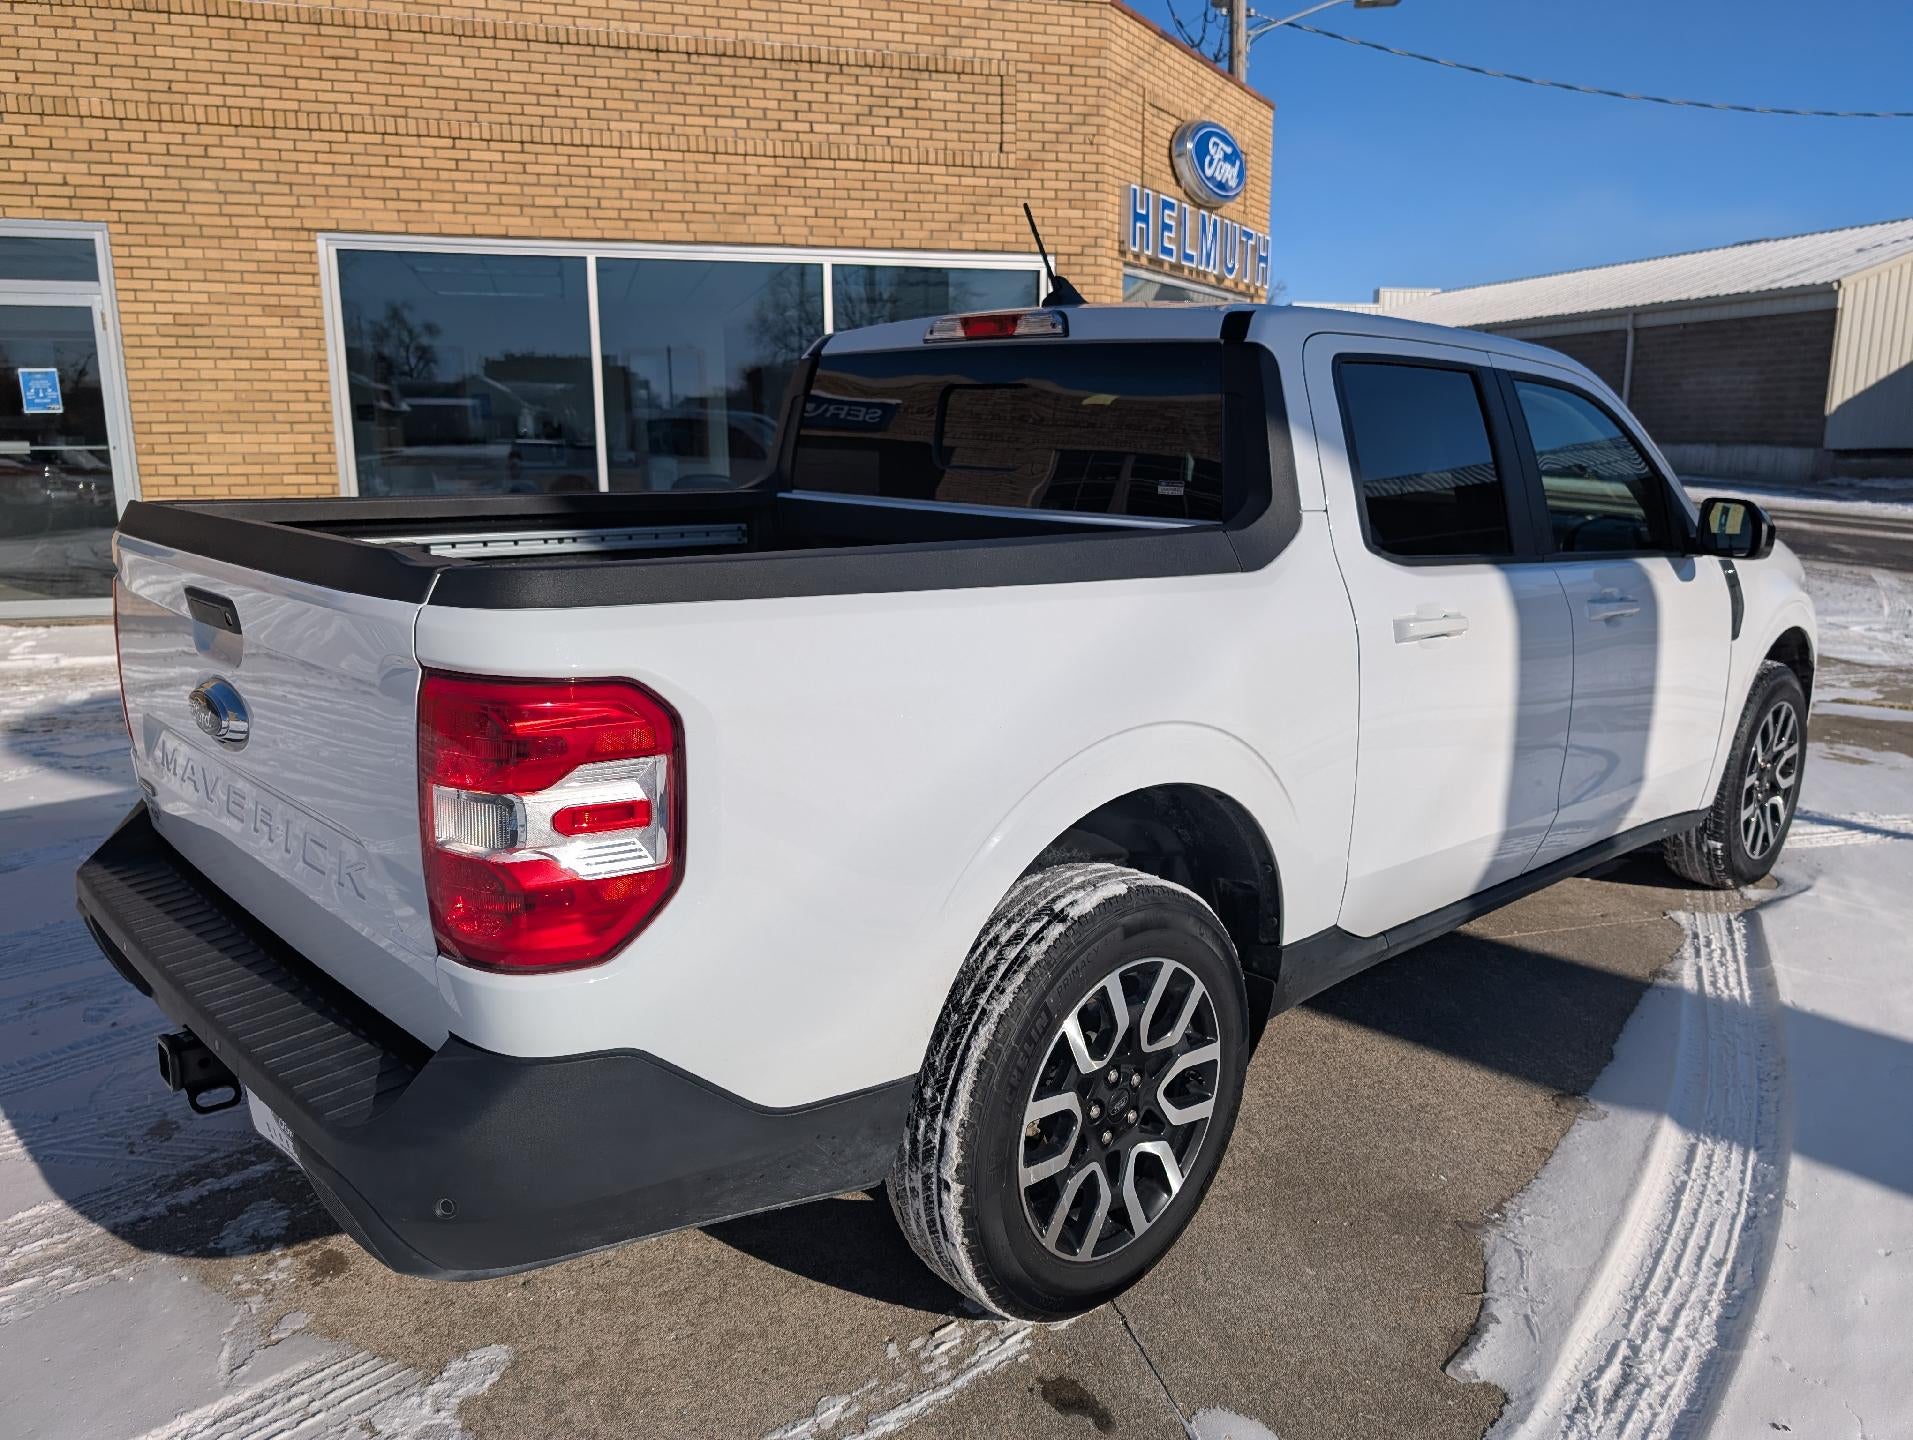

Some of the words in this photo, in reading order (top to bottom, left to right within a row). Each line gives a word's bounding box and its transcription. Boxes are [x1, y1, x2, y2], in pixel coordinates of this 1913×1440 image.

[1205, 136, 1241, 188] Ford
[1130, 184, 1271, 288] HELMUTH
[159, 740, 367, 901] MAVERICK
[1001, 1010, 1049, 1118] CHELIN
